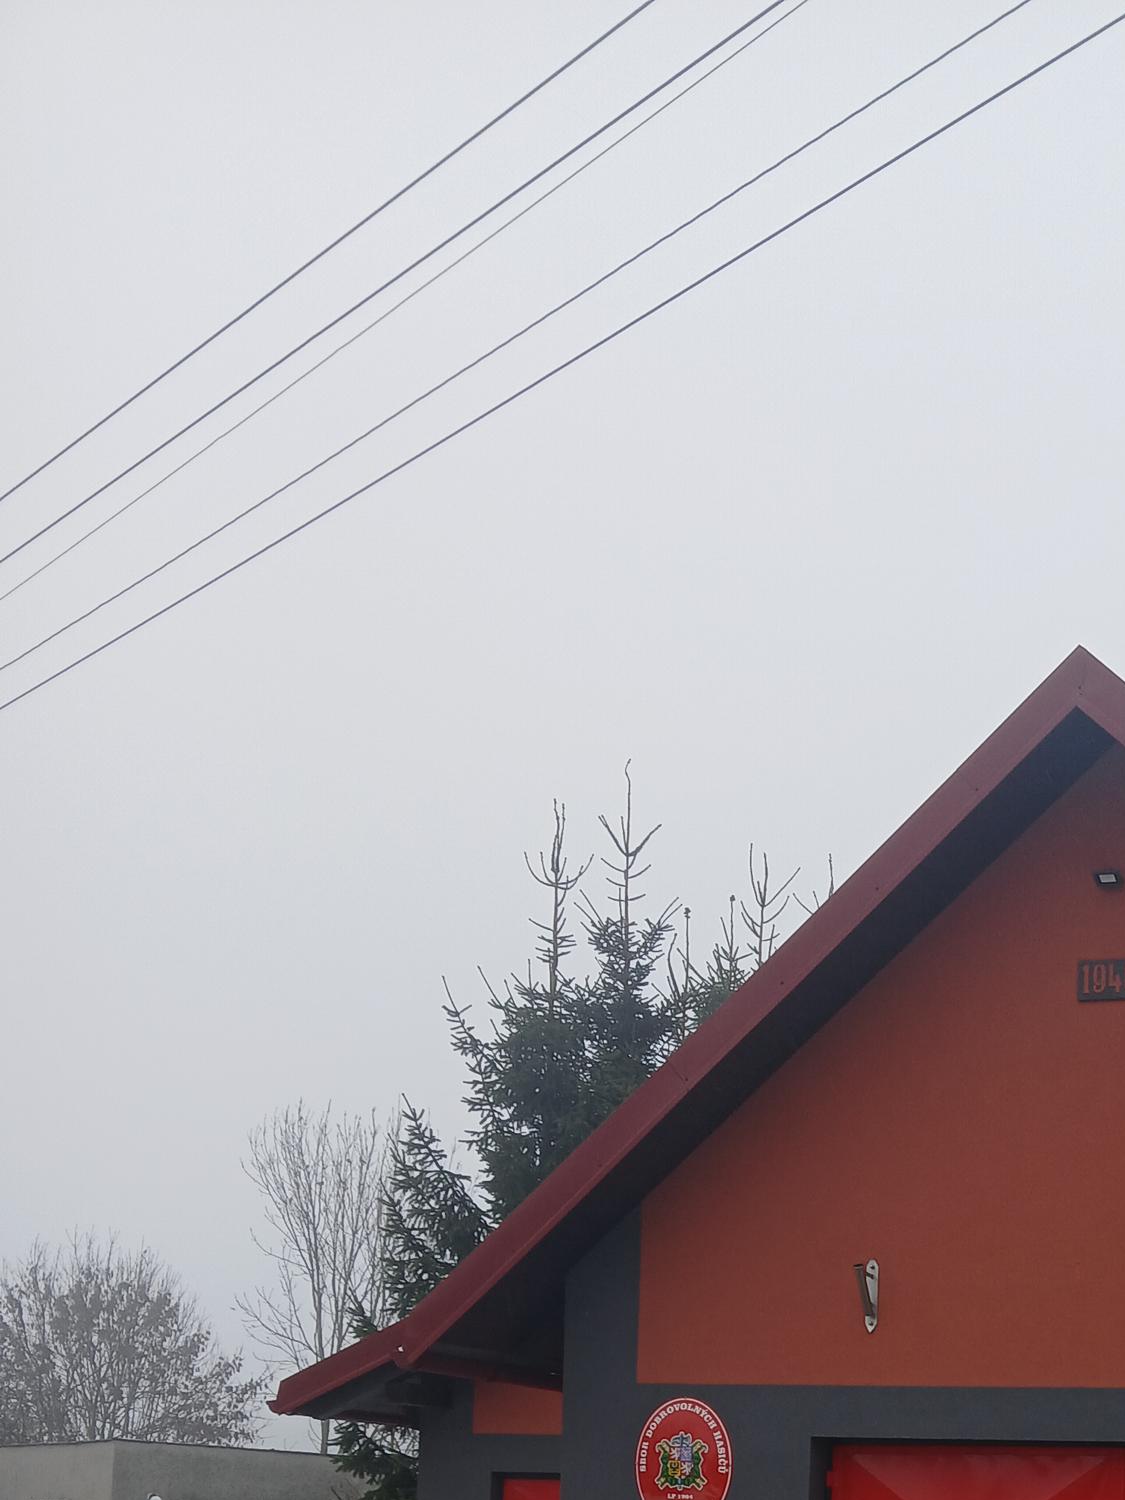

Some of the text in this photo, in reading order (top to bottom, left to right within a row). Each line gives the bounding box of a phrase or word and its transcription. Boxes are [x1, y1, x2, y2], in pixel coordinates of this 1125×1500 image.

[639, 1402, 729, 1473] SBOR DOBROVOLNÝCH HASIČŮ
